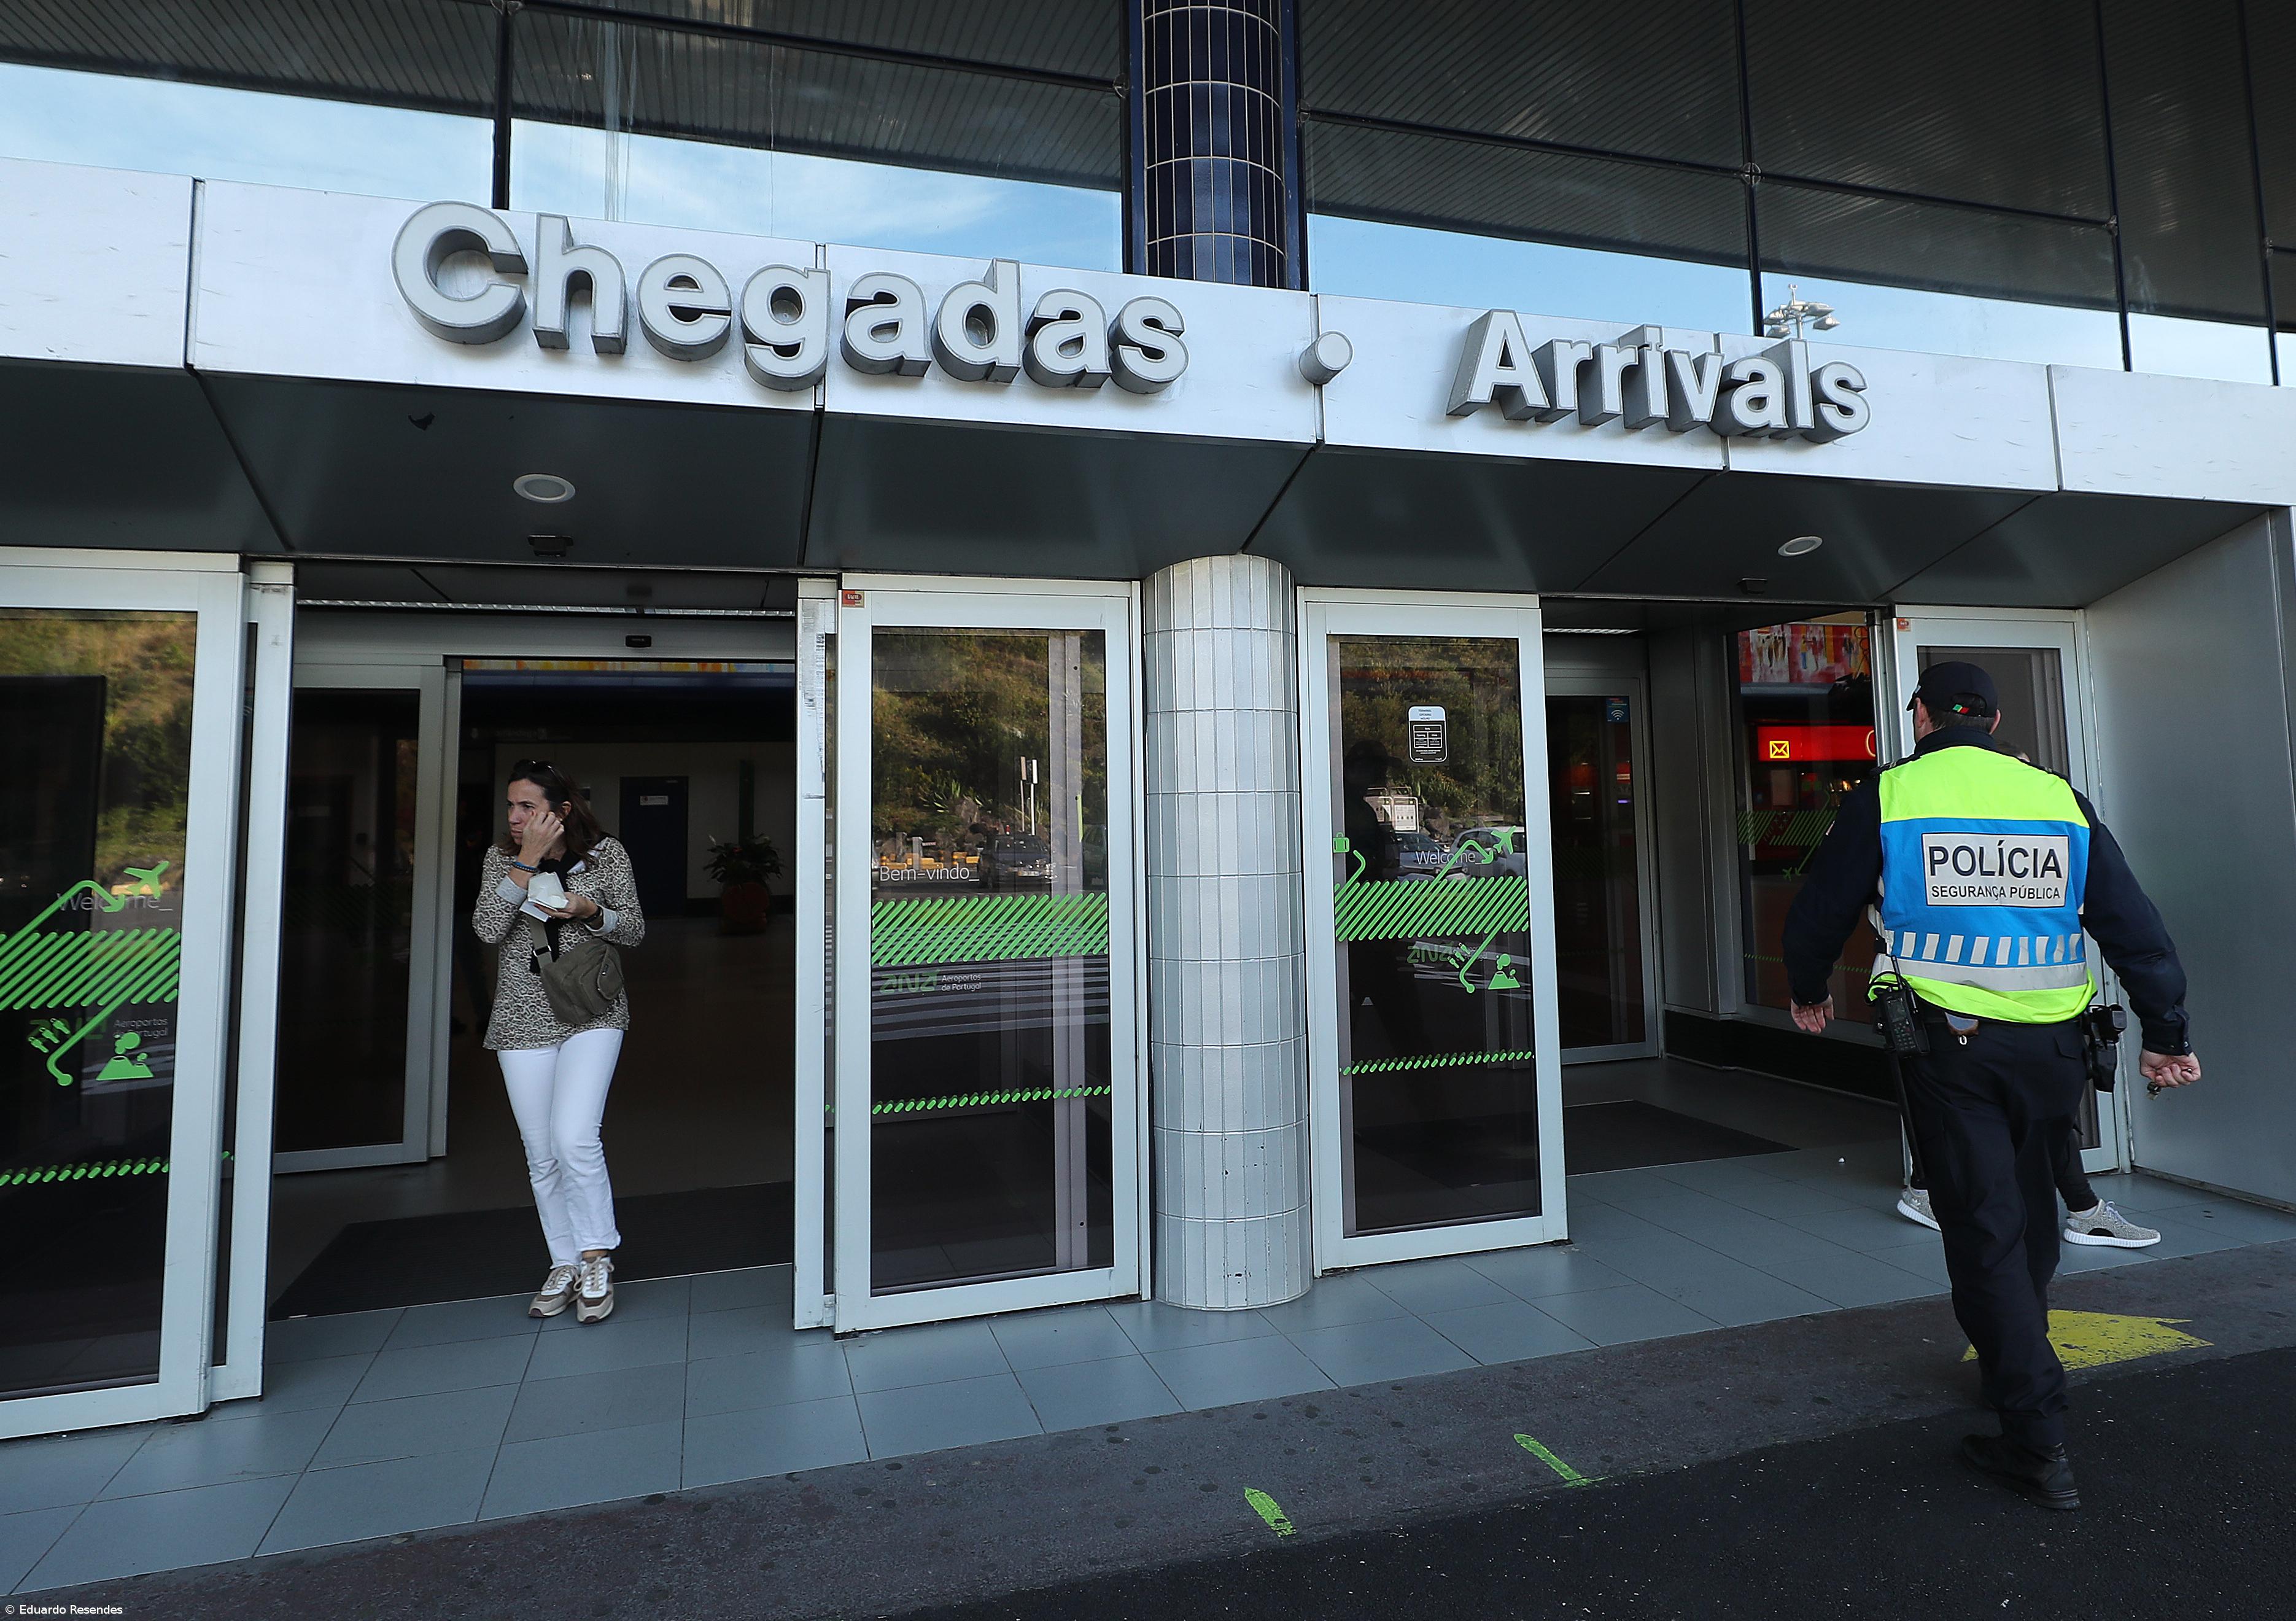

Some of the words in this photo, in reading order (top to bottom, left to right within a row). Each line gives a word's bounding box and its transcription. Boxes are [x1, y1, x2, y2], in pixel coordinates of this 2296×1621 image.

[390, 200, 1190, 391] Chegadas
[1448, 309, 1872, 444] Arrivals
[1928, 839, 2063, 879] POLÍCIA
[1931, 885, 2006, 900] SEGURANÇA
[2010, 885, 2060, 899] PÚBLICA
[941, 974, 982, 982] Aeroportos
[952, 982, 982, 992] Portugal
[114, 1018, 168, 1029] Aeroportos
